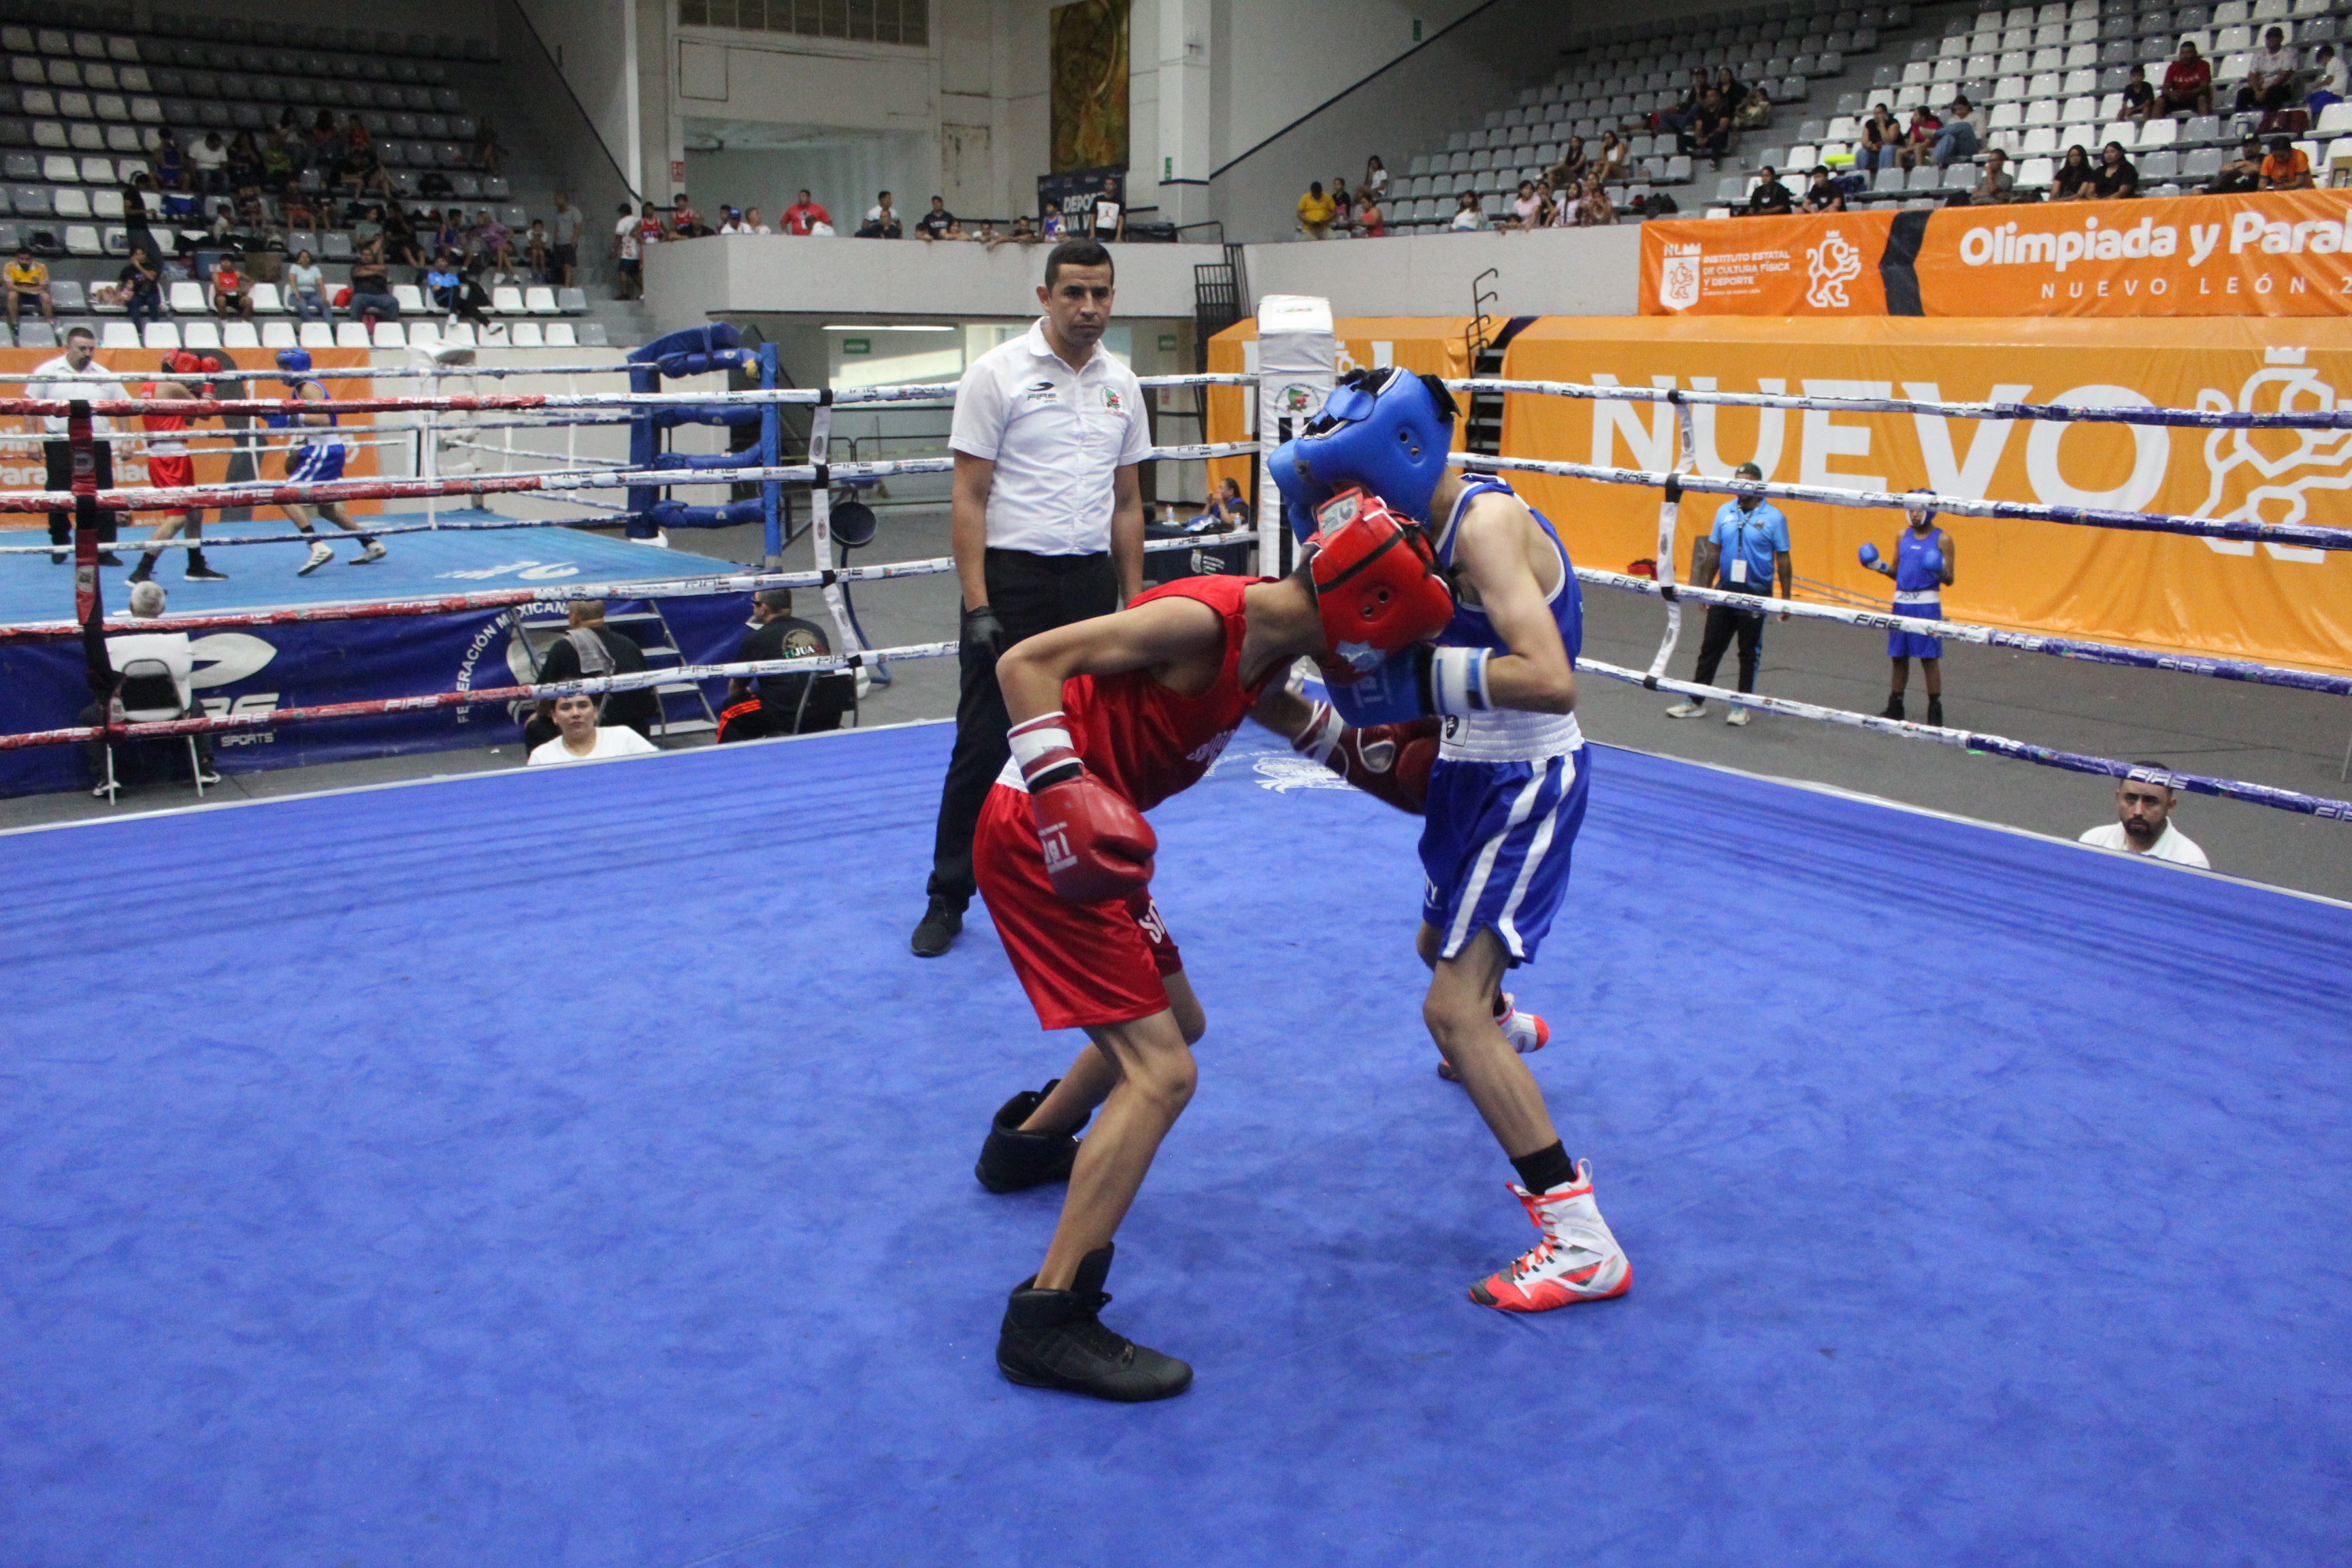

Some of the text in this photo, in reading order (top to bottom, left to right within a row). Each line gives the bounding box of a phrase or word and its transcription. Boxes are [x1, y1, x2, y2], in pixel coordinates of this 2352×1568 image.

[1063, 192, 1106, 213] DEPO
[1960, 216, 2177, 272] Olimpiada
[2188, 224, 2221, 267] y
[1703, 250, 1791, 263] INSTITUTO ESTATAL
[1703, 260, 1790, 275] DE CULTURA FÍSICA
[1712, 276, 1754, 286] DEPORTE
[2042, 278, 2168, 298] NUEVO
[2200, 273, 2306, 294] LEÓN
[1028, 393, 1056, 401] FIRE
[1590, 373, 2170, 516] NUEVO
[1612, 576, 1649, 590] FIRE
[1724, 593, 1765, 607] FIRE
[1853, 613, 1903, 630] FIRE
[1992, 634, 2044, 651] FIRE
[456, 624, 498, 723] FEERACIÓN
[495, 601, 570, 630] MXICAN
[2156, 657, 2217, 674] FIRE
[383, 696, 440, 711] FIRE
[210, 712, 270, 726] FIRE
[221, 732, 274, 747] SPORTS
[2127, 768, 2190, 790] FIRE
